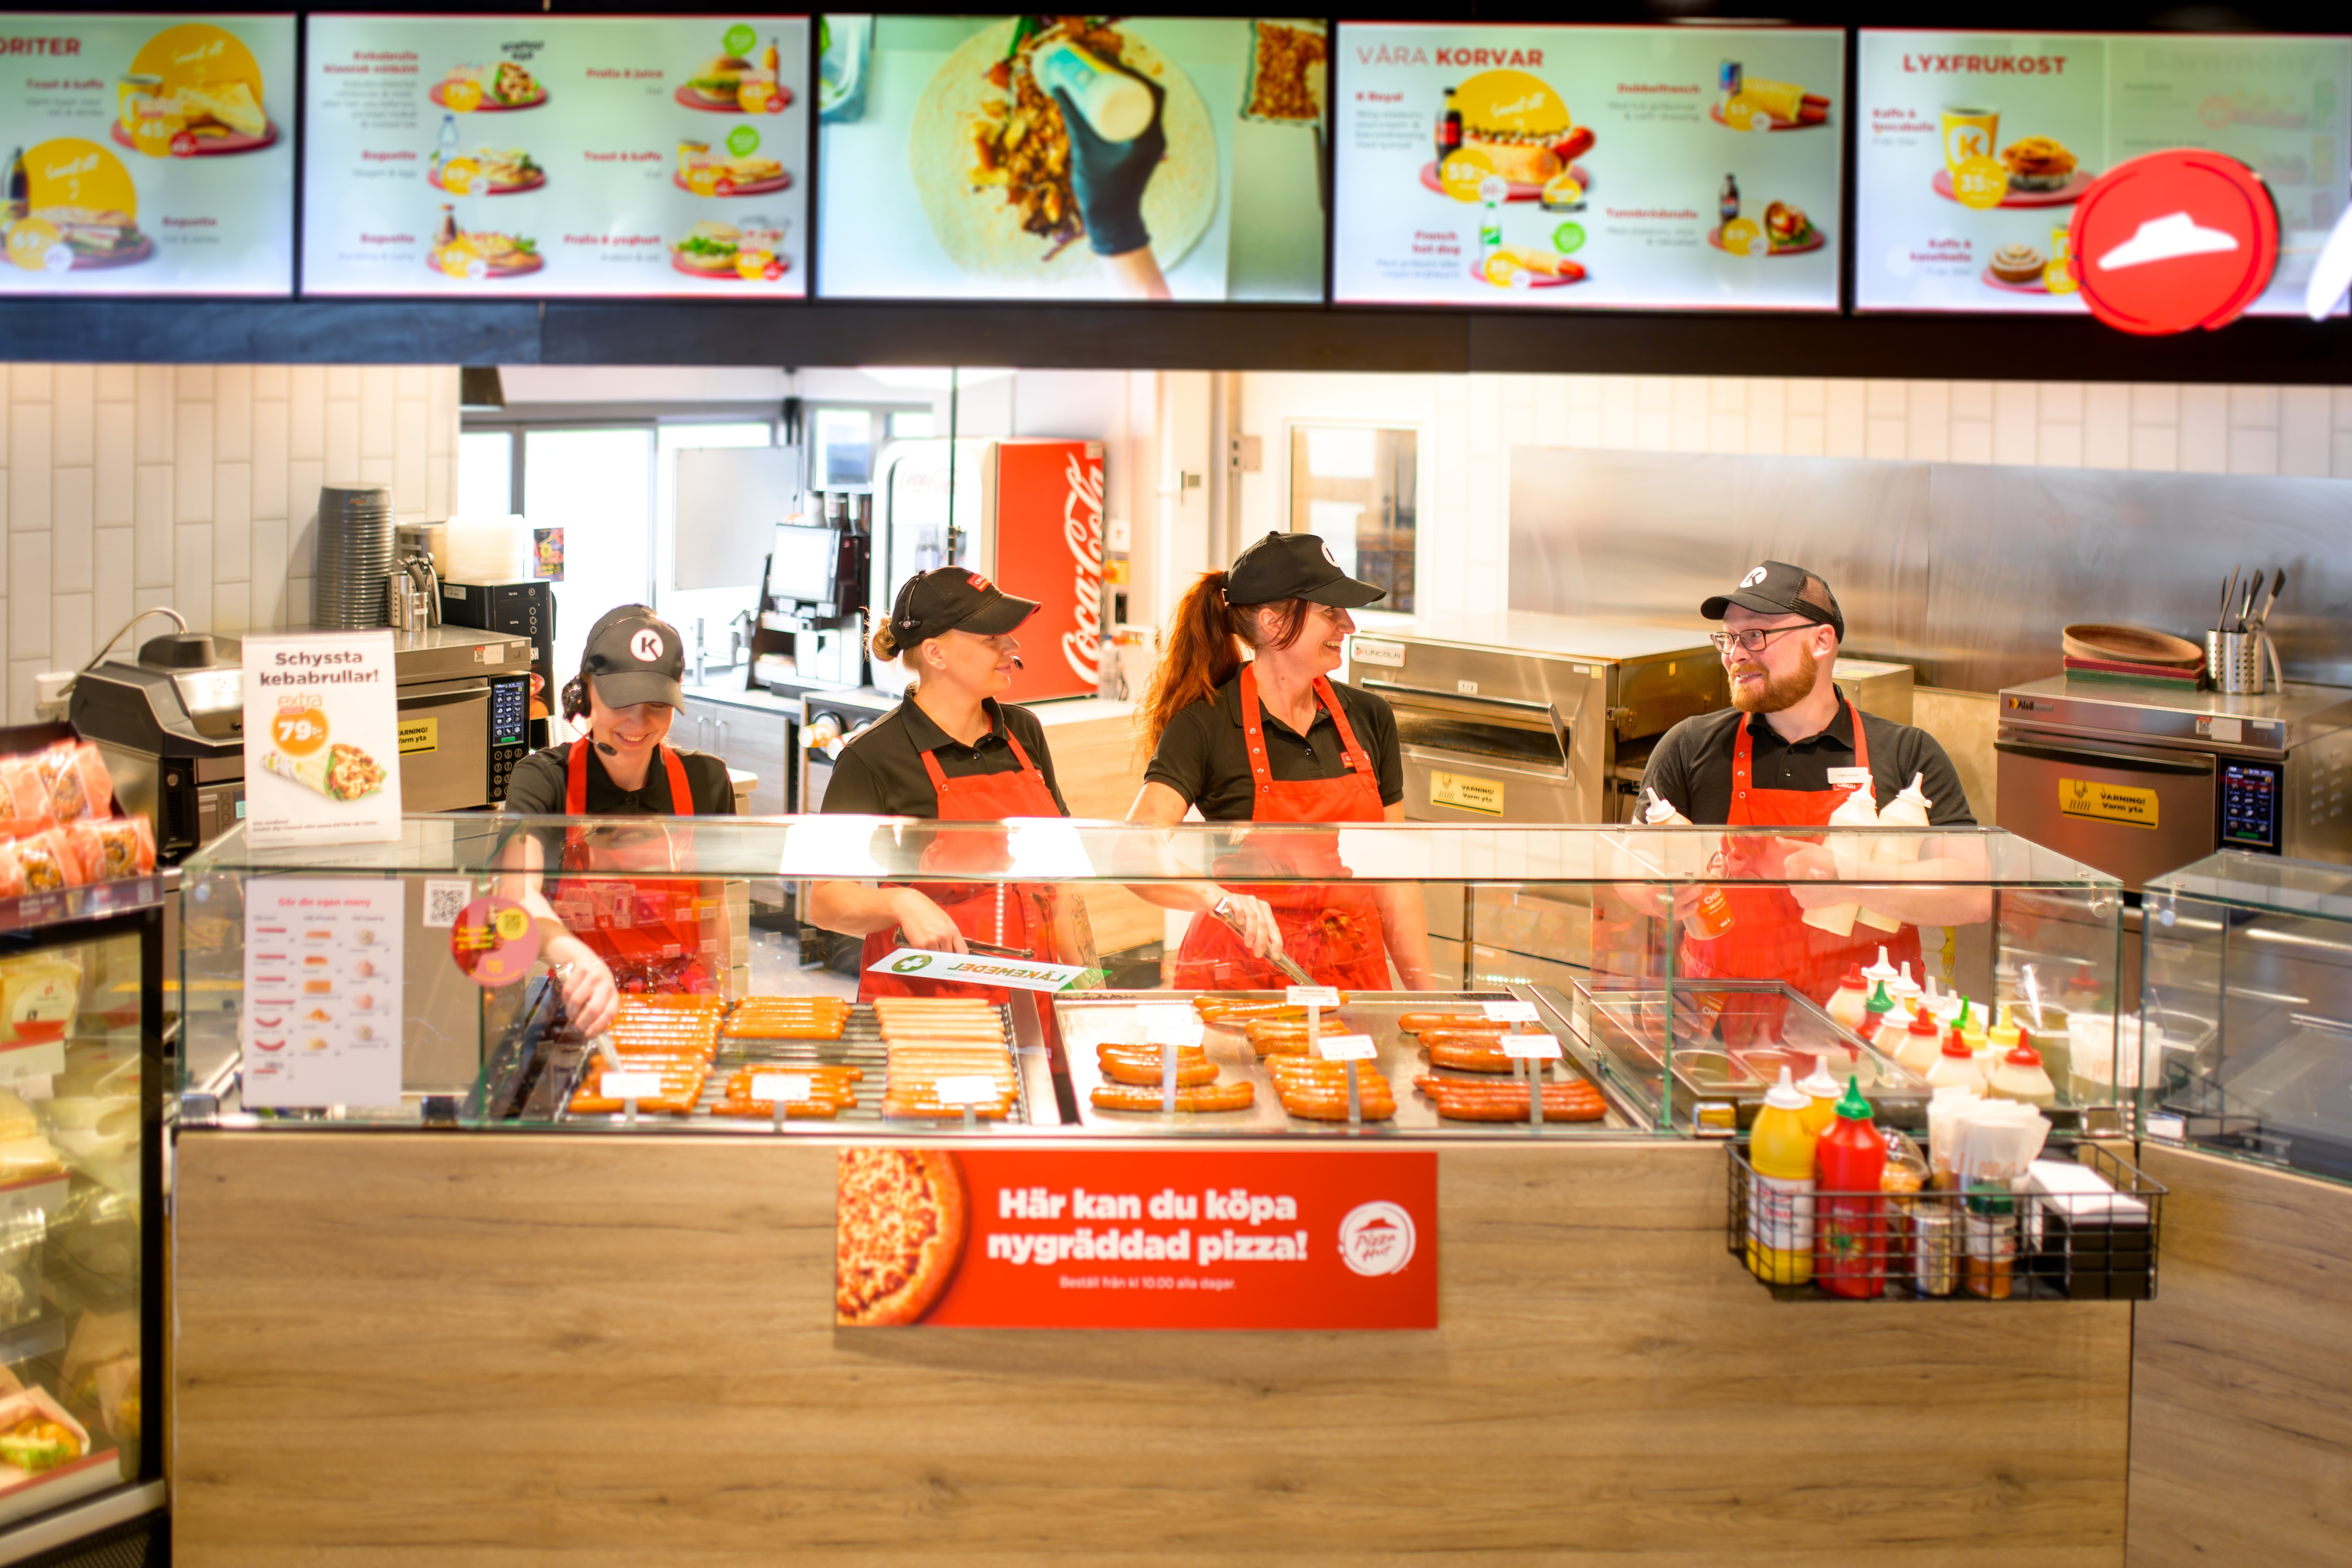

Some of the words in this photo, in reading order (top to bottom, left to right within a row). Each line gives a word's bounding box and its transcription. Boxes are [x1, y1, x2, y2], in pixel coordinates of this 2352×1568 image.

[354, 52, 419, 61] Kebabrulle
[1357, 44, 1428, 65] VÅRA
[1436, 48, 1544, 67] KORVAR
[1904, 55, 2067, 74] LYXFRUKOST
[587, 69, 621, 78] Fralla
[633, 69, 664, 80] juice
[26, 80, 59, 89] Toast
[63, 80, 70, 89] &
[74, 80, 104, 89] kaffe
[1618, 84, 1700, 94] Dubbelfrench
[1368, 93, 1403, 103] Royal
[1873, 109, 1905, 118] Kaffe
[1958, 134, 1982, 157] K
[363, 151, 417, 161] Baguette
[584, 152, 617, 162] Toast
[621, 152, 628, 161] &
[631, 152, 662, 162] kaffe
[162, 218, 217, 228] Baguette
[361, 234, 415, 244] Baguette
[564, 236, 598, 245] Fralla
[613, 235, 661, 246] yoghurt
[1929, 240, 1961, 249] Kaffe
[1413, 245, 1433, 254] hot
[1437, 245, 1460, 255] dog
[641, 637, 661, 659] K
[1365, 648, 1401, 659] LINCOLN
[275, 651, 363, 667] Schyssta
[260, 669, 379, 687] kebabrullar!
[277, 692, 323, 708] extra
[397, 727, 428, 737] ARNING!
[415, 735, 426, 744] yta
[1461, 784, 1494, 796] VARNING!
[1463, 793, 1479, 801] Varm
[2100, 792, 2145, 806] VARNING!
[2102, 802, 2126, 811] Varm
[2129, 806, 2143, 815] yta
[278, 898, 296, 907] Gör
[299, 898, 313, 906] din
[317, 899, 341, 907] egen
[344, 899, 371, 908] meny
[999, 1189, 1067, 1220] Här
[1072, 1189, 1141, 1220] kan
[1148, 1189, 1198, 1220] du
[1205, 1189, 1298, 1226] köpa
[987, 1229, 1190, 1266] nygräddad
[1198, 1230, 1308, 1266] pizza!
[1355, 1233, 1397, 1252] Pizza
[1361, 1245, 1394, 1263] Hut
[1060, 1275, 1098, 1290] Beställ
[1102, 1275, 1126, 1289] från
[1129, 1275, 1140, 1289] kl
[1142, 1276, 1174, 1290] 10.00
[1177, 1276, 1198, 1290] alla
[1200, 1277, 1236, 1293] dagar.
